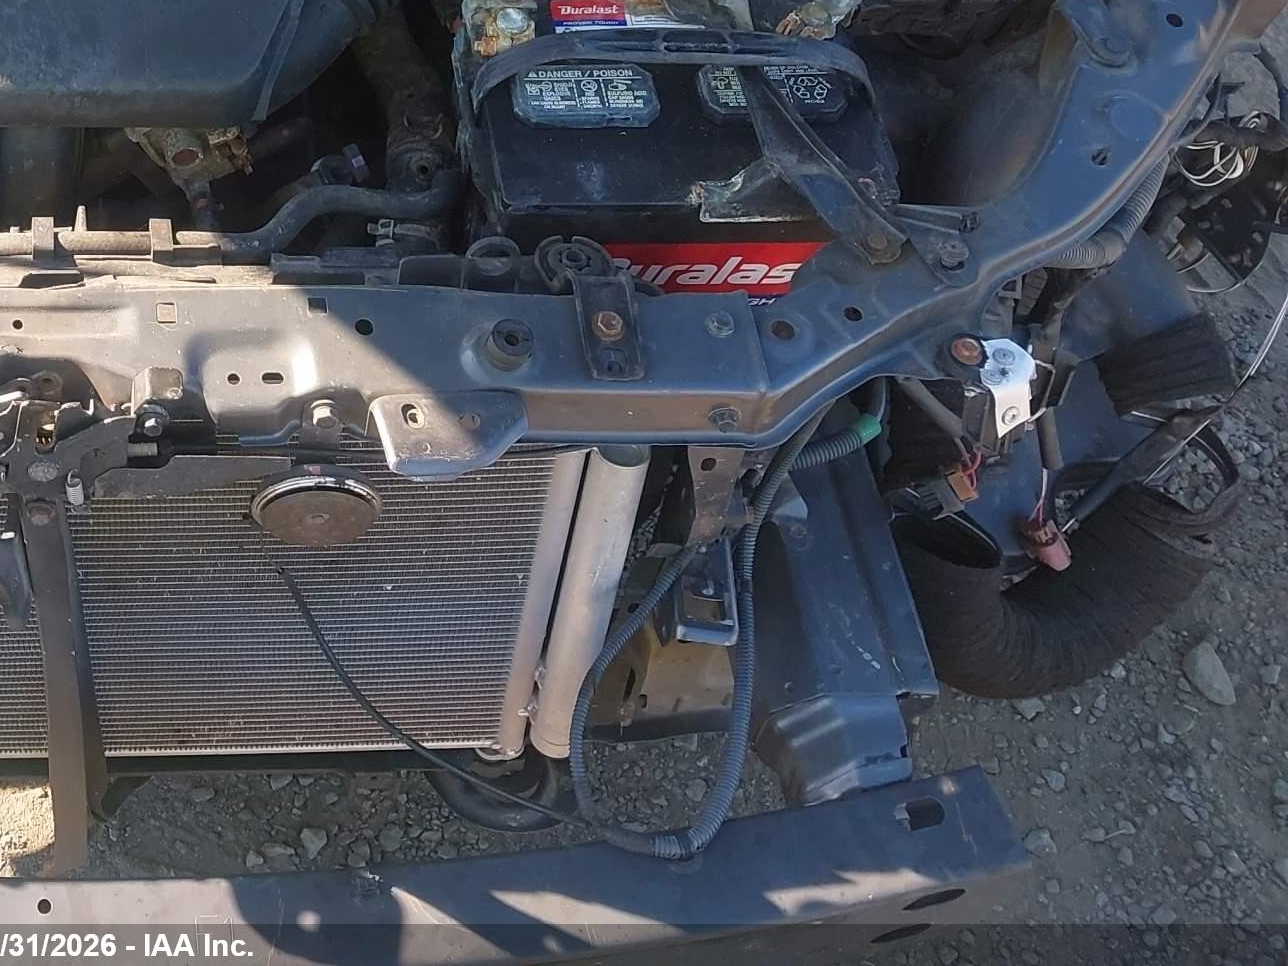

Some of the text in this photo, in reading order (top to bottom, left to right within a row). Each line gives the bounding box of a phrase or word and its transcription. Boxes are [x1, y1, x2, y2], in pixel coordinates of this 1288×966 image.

[557, 4, 620, 15] Duralast
[538, 70, 582, 78] DANGER
[593, 69, 633, 77] POISON
